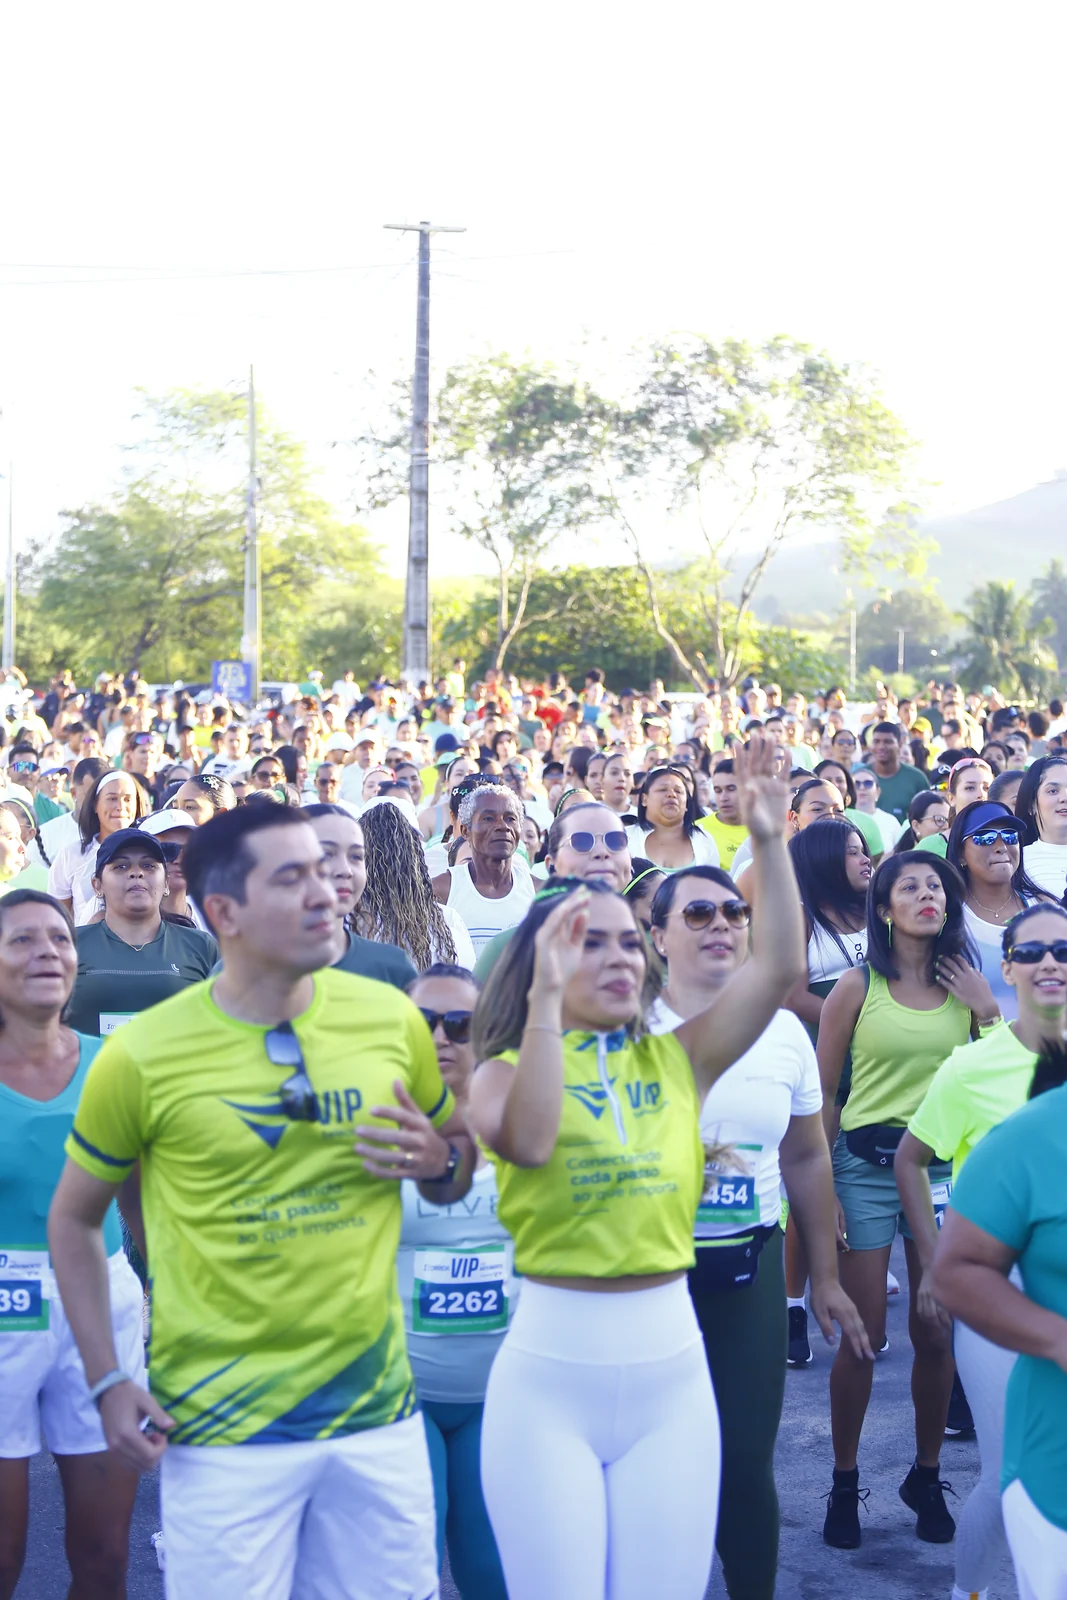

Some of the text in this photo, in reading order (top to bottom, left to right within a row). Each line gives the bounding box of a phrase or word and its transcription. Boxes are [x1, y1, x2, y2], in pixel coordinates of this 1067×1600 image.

[316, 1088, 362, 1125] VIP
[625, 1080, 661, 1109] VIP
[570, 1167, 660, 1186] cada passo
[236, 1200, 340, 1224] cada passo
[263, 1226, 298, 1244] que
[450, 1257, 480, 1279] VIP
[428, 1289, 498, 1314] 2262
